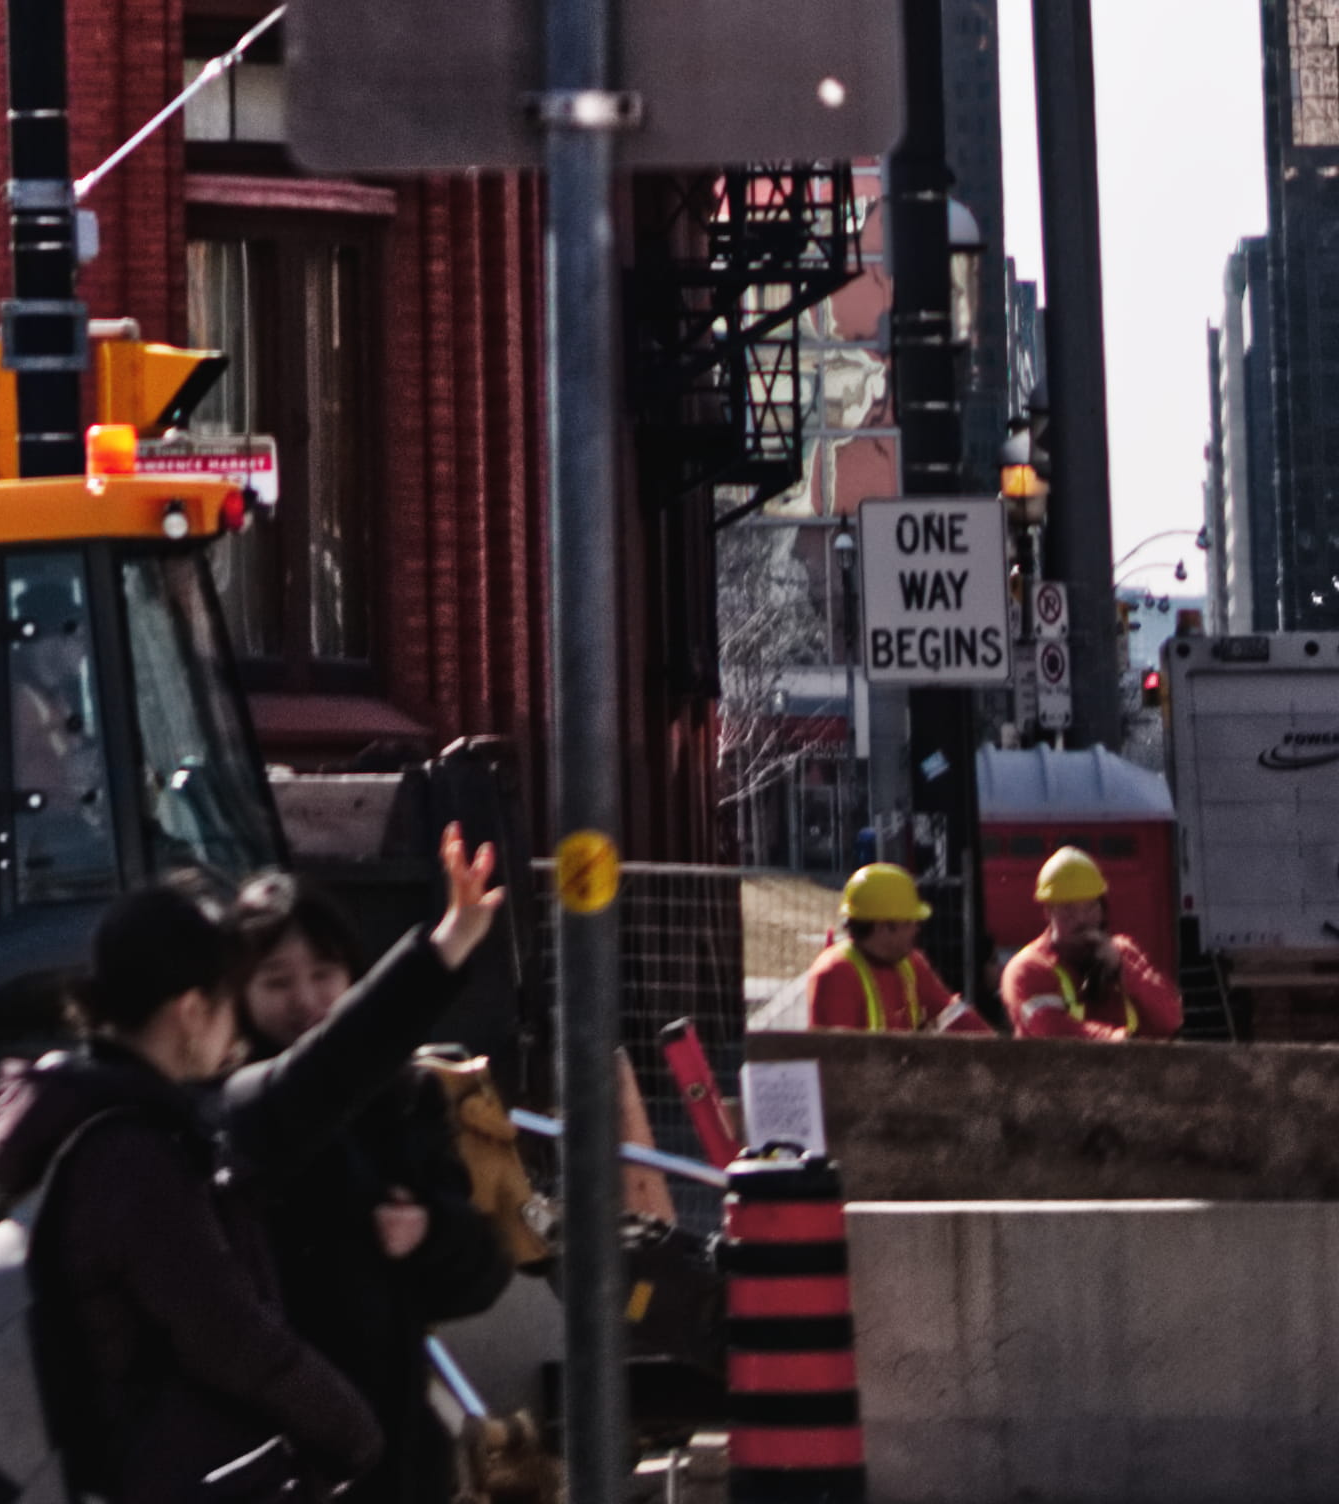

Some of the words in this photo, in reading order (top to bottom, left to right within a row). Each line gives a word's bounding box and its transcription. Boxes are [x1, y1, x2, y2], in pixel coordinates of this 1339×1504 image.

[895, 512, 969, 555] ONE
[898, 569, 969, 612] WAY
[871, 627, 1003, 670] BEGINS
